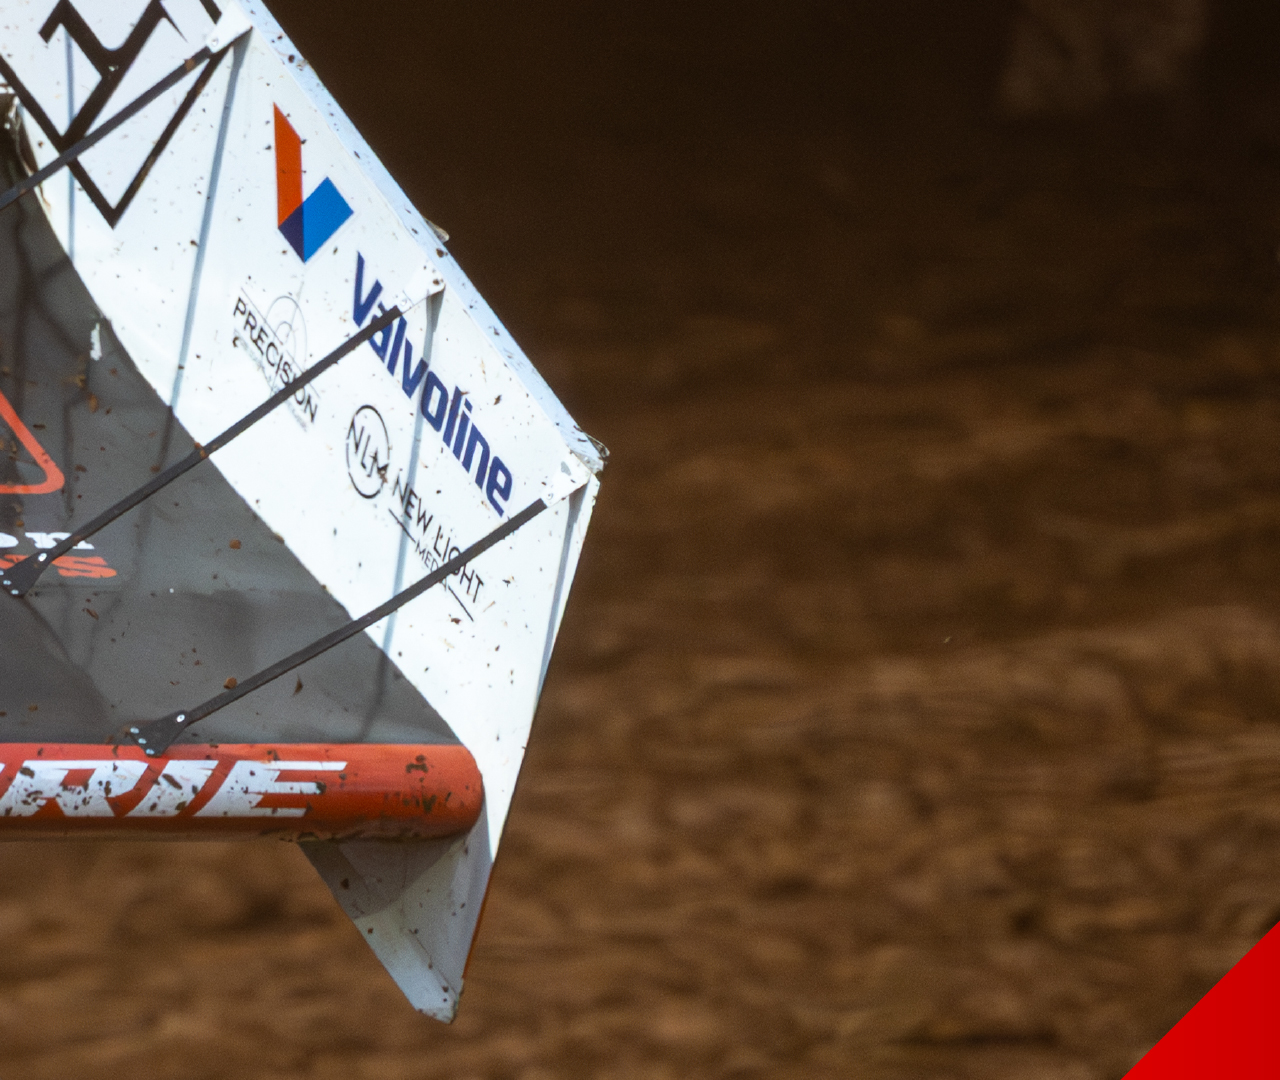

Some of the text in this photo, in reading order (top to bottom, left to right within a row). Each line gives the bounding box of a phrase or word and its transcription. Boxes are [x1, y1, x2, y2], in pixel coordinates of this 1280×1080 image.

[353, 250, 512, 518] Valvoline
[393, 473, 434, 535] NEW
[415, 540, 448, 592] MED
